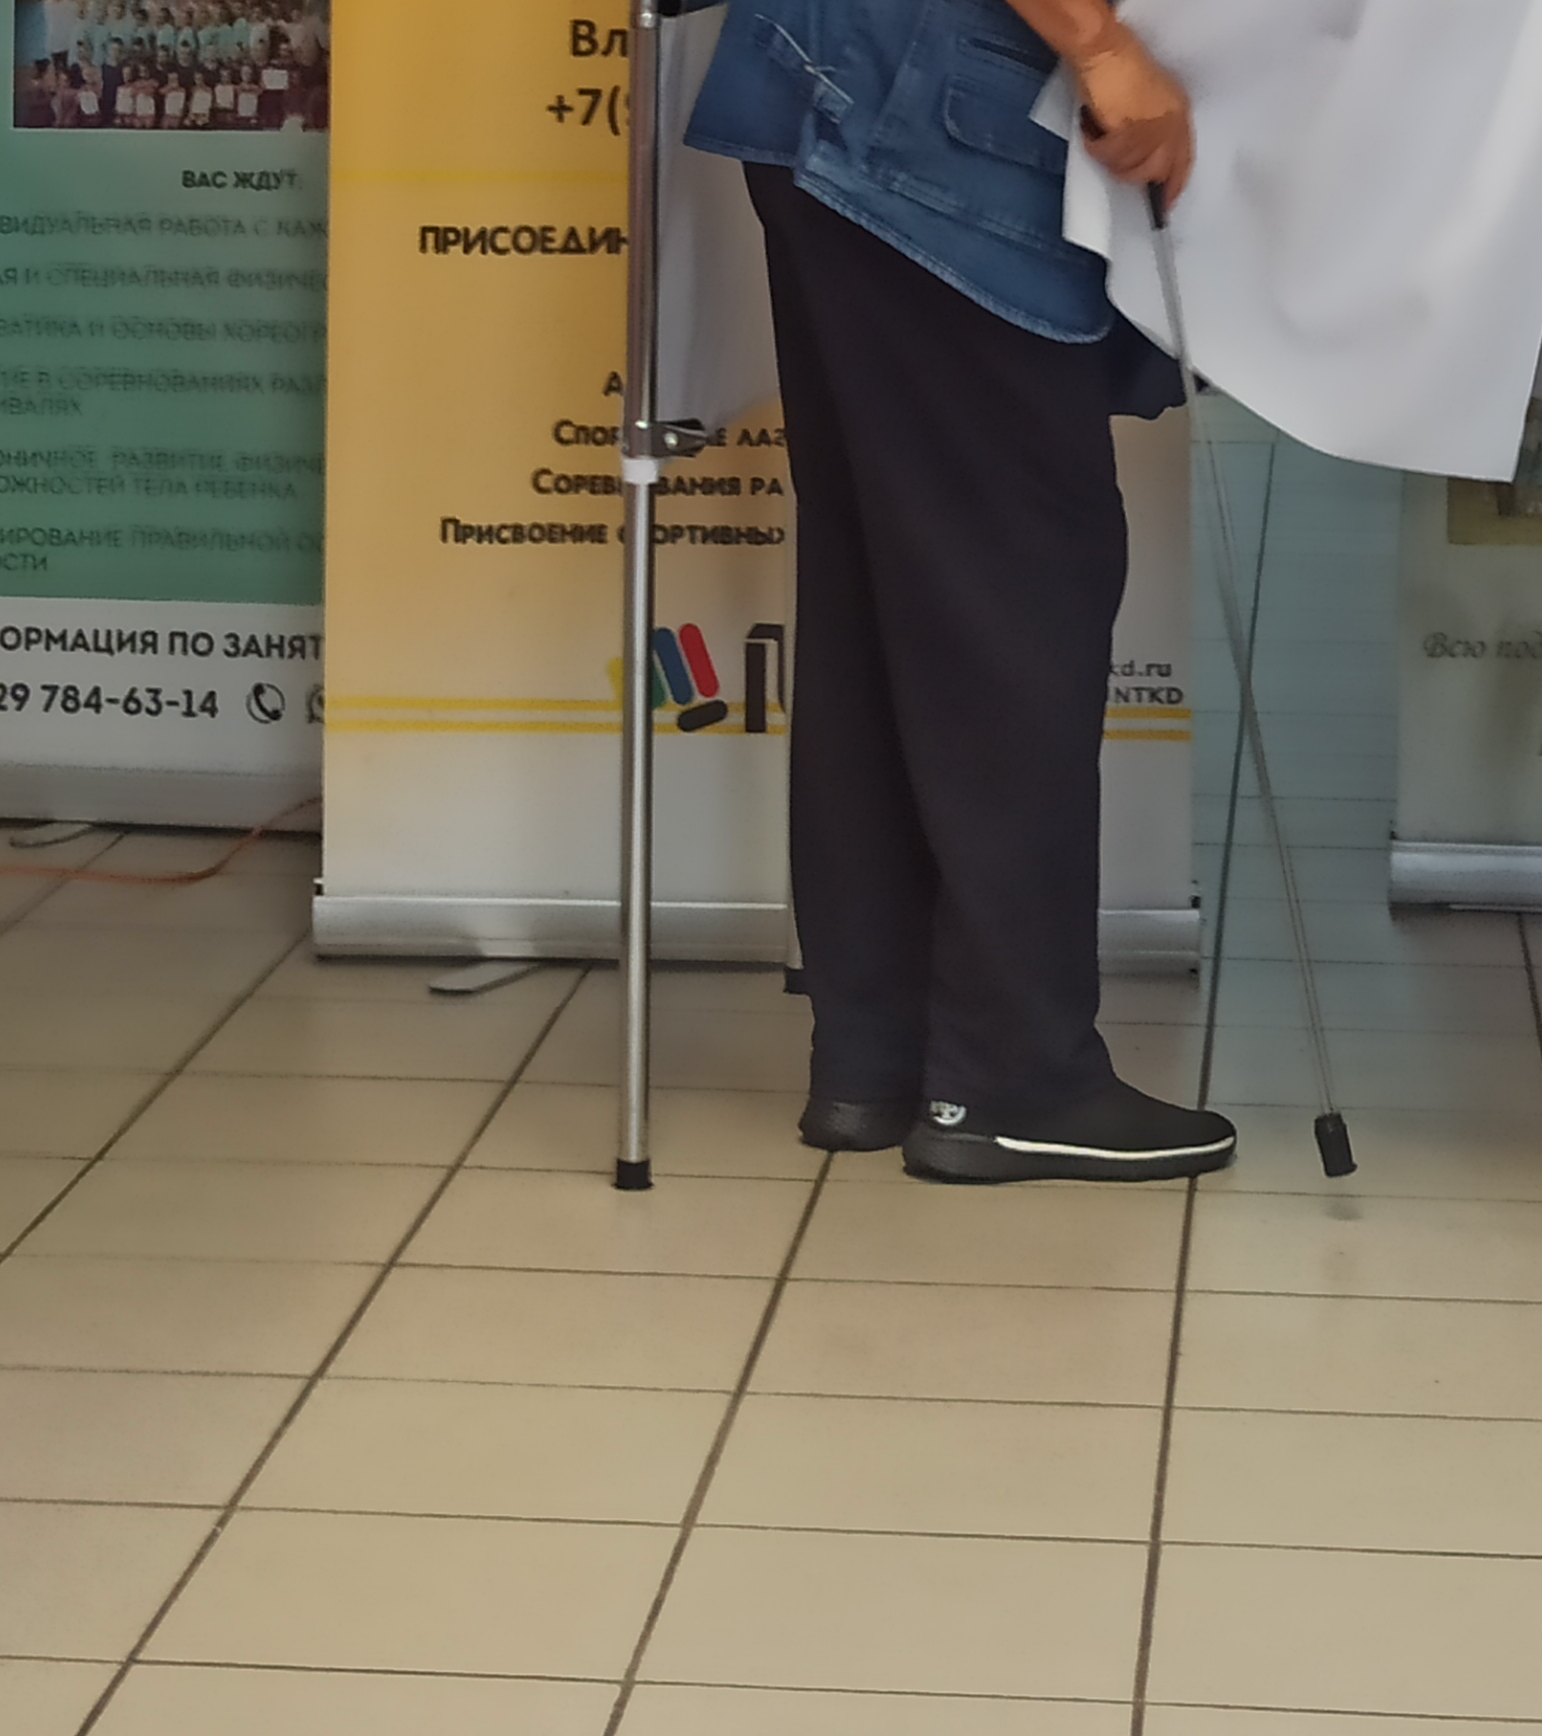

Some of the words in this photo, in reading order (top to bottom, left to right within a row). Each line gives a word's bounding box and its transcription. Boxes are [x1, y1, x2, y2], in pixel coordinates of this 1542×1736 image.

[182, 170, 228, 189] ВАС
[160, 217, 246, 238] РАБОТА
[57, 368, 264, 395] СОРЕВНОВАНИЯХ
[133, 475, 188, 497] ТЕЛА
[531, 468, 742, 497] Сореввания
[440, 517, 609, 545] Присвоение
[168, 631, 214, 657] ПО
[1422, 631, 1486, 658] Всю
[40, 684, 219, 718] 784-63-14
